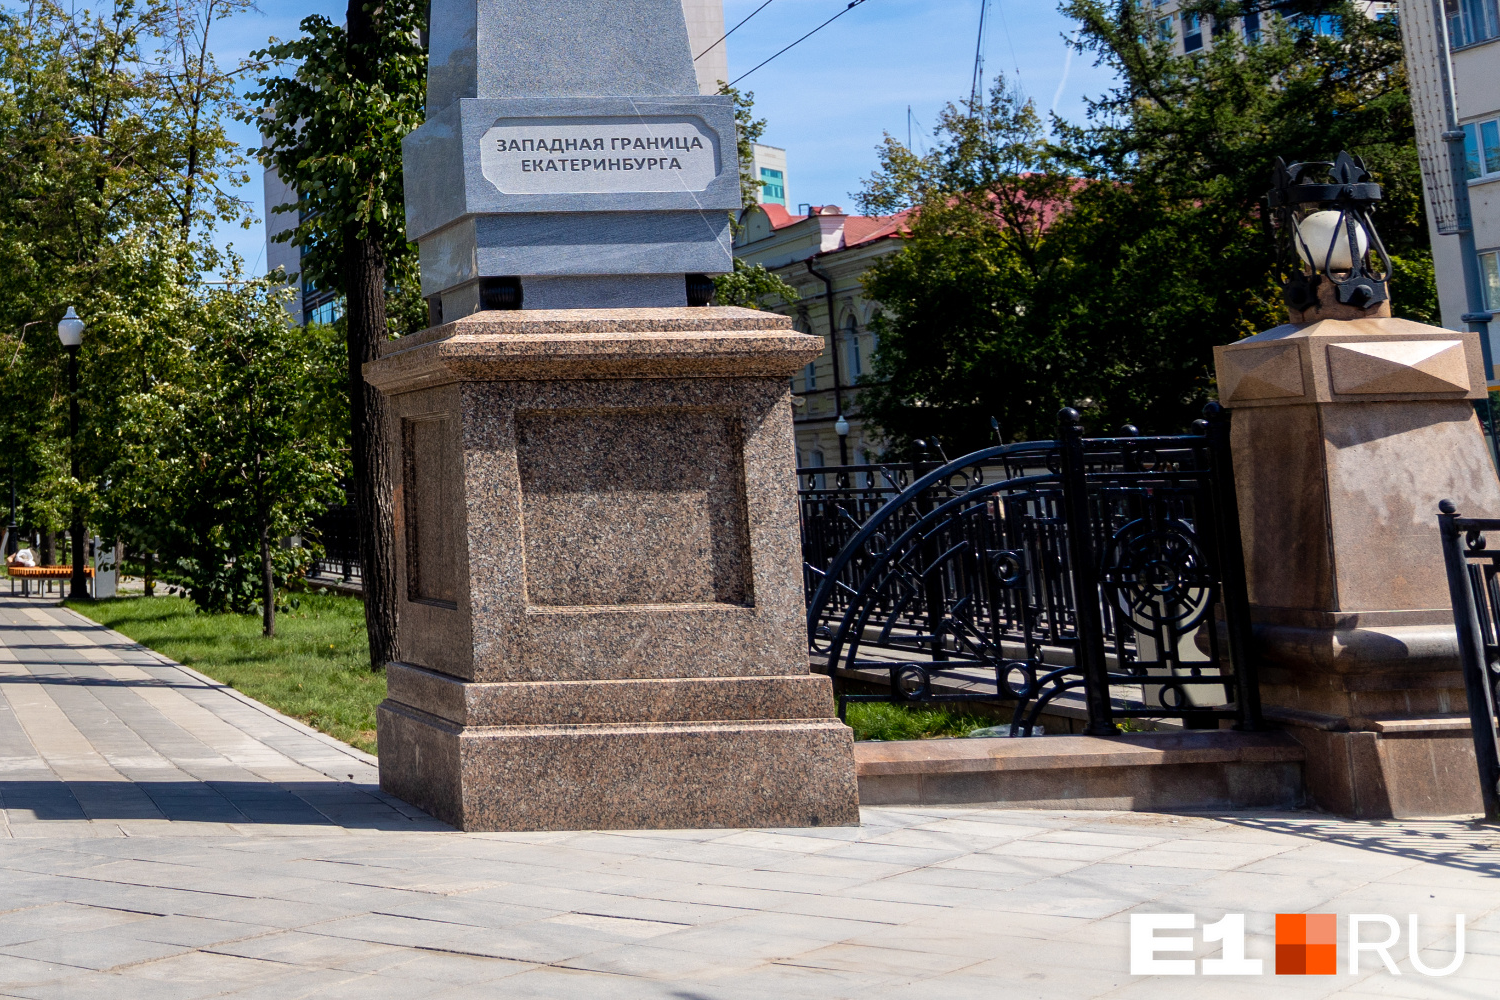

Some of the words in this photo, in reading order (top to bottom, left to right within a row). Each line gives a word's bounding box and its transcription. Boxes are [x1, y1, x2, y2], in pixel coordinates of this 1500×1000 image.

[496, 138, 604, 153] ЗАПАДНАЯ
[610, 136, 703, 152] ГРАНИЦА
[521, 157, 682, 172] ЕКАТЕРИНБУРГА
